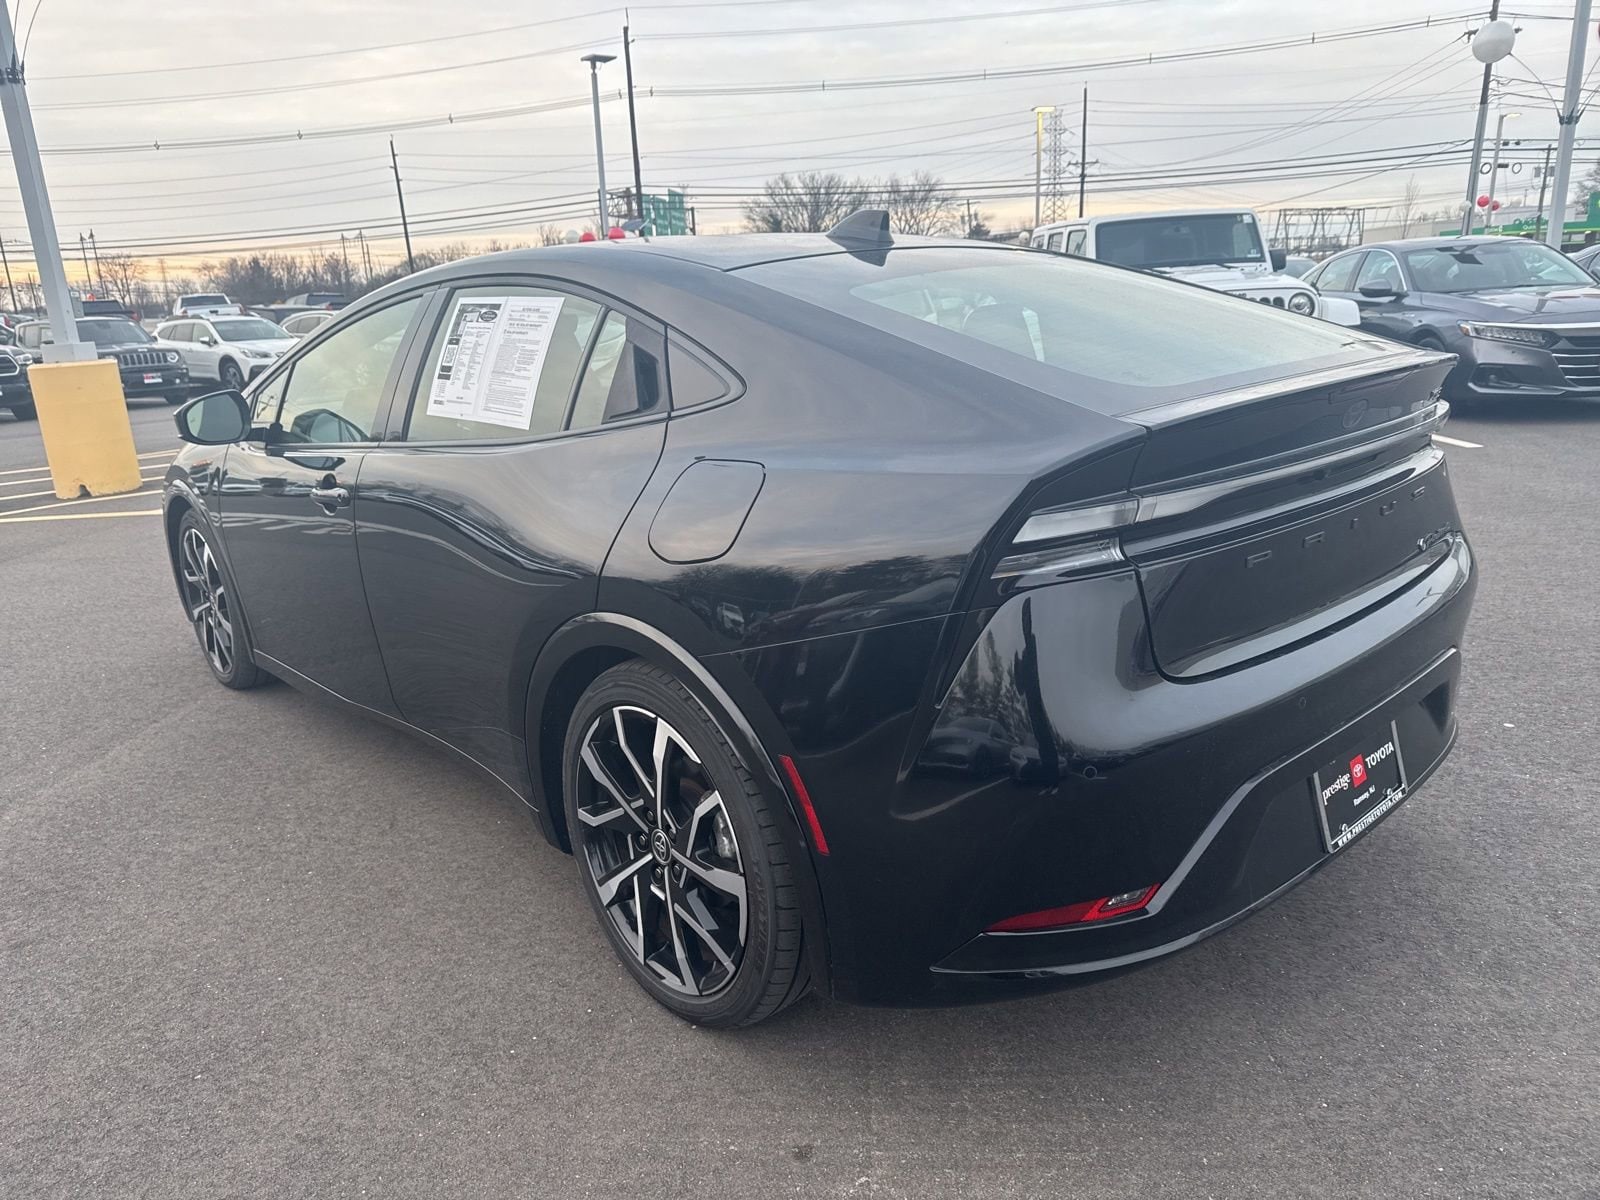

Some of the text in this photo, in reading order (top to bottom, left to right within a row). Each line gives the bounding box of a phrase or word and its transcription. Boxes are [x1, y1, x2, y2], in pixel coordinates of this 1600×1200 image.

[1322, 741, 1394, 805] prestige TOYOTA
[1337, 791, 1403, 847] WWW.PRESTIGETOYOTA.COM
